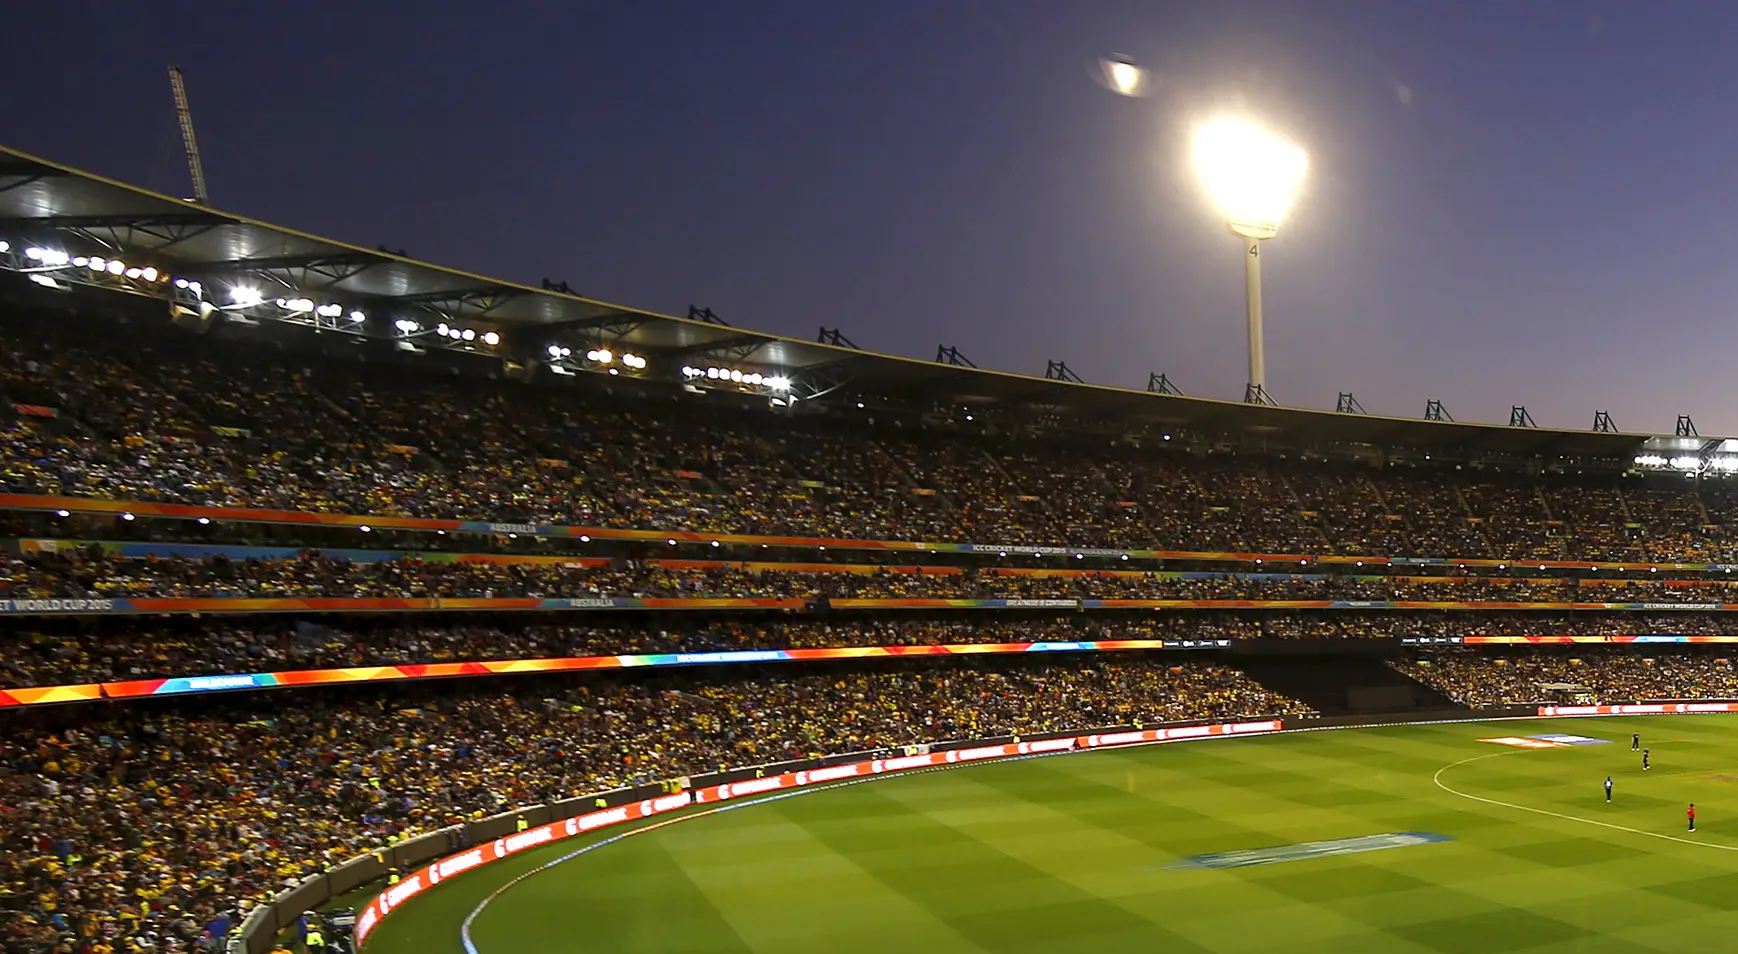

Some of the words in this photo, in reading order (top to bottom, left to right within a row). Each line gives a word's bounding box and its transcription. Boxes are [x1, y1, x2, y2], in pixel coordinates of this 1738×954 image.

[16, 600, 60, 610] WORLD
[62, 600, 86, 610] CUP
[87, 600, 112, 610] 2015
